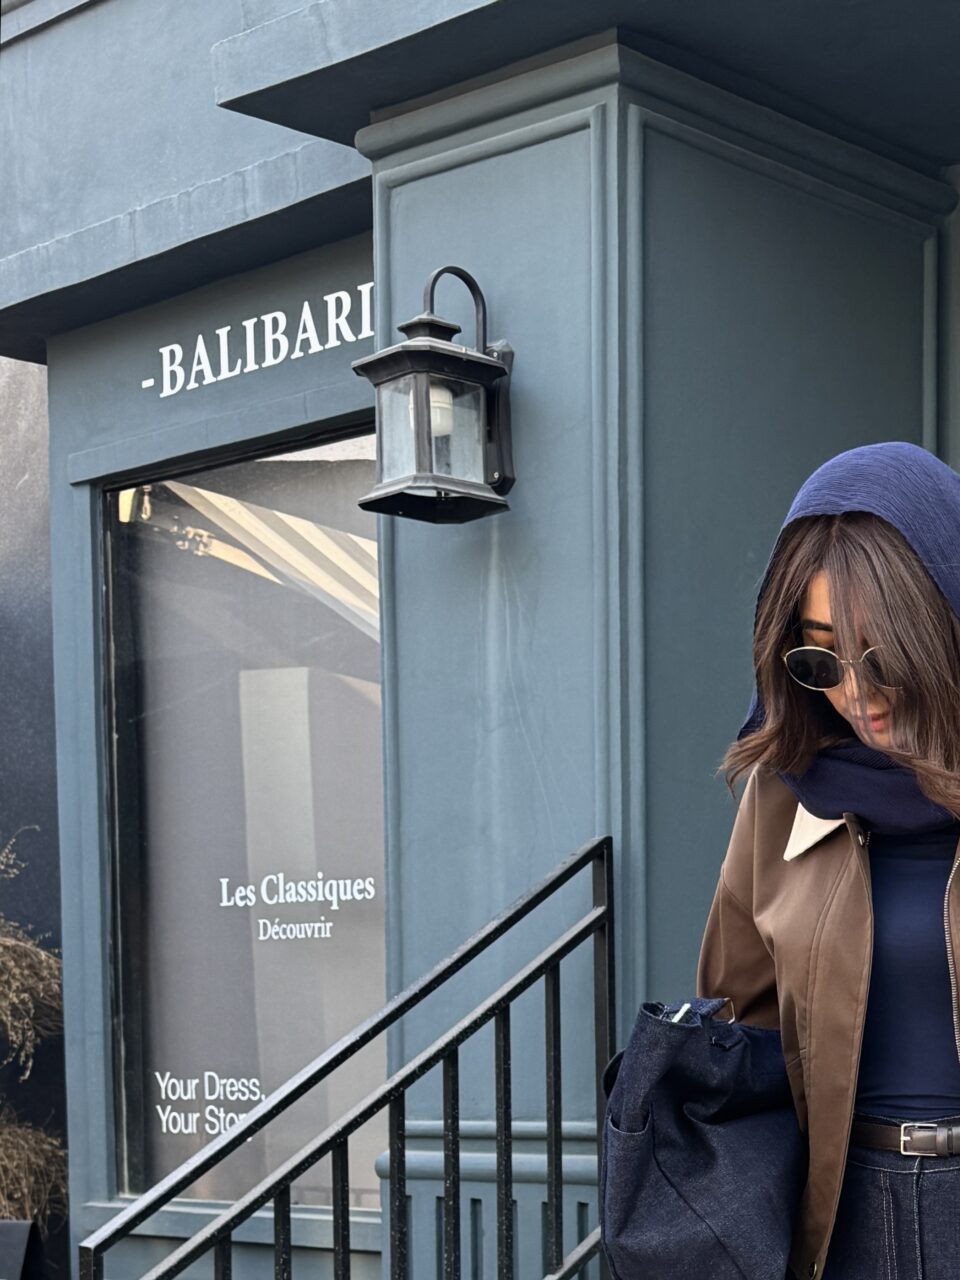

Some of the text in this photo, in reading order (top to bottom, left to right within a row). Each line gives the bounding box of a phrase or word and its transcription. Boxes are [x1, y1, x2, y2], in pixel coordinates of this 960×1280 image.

[219, 871, 375, 910] Les Classiques
[258, 916, 333, 940] Découvrir
[154, 1071, 199, 1101] Your
[155, 1105, 200, 1134] Your
